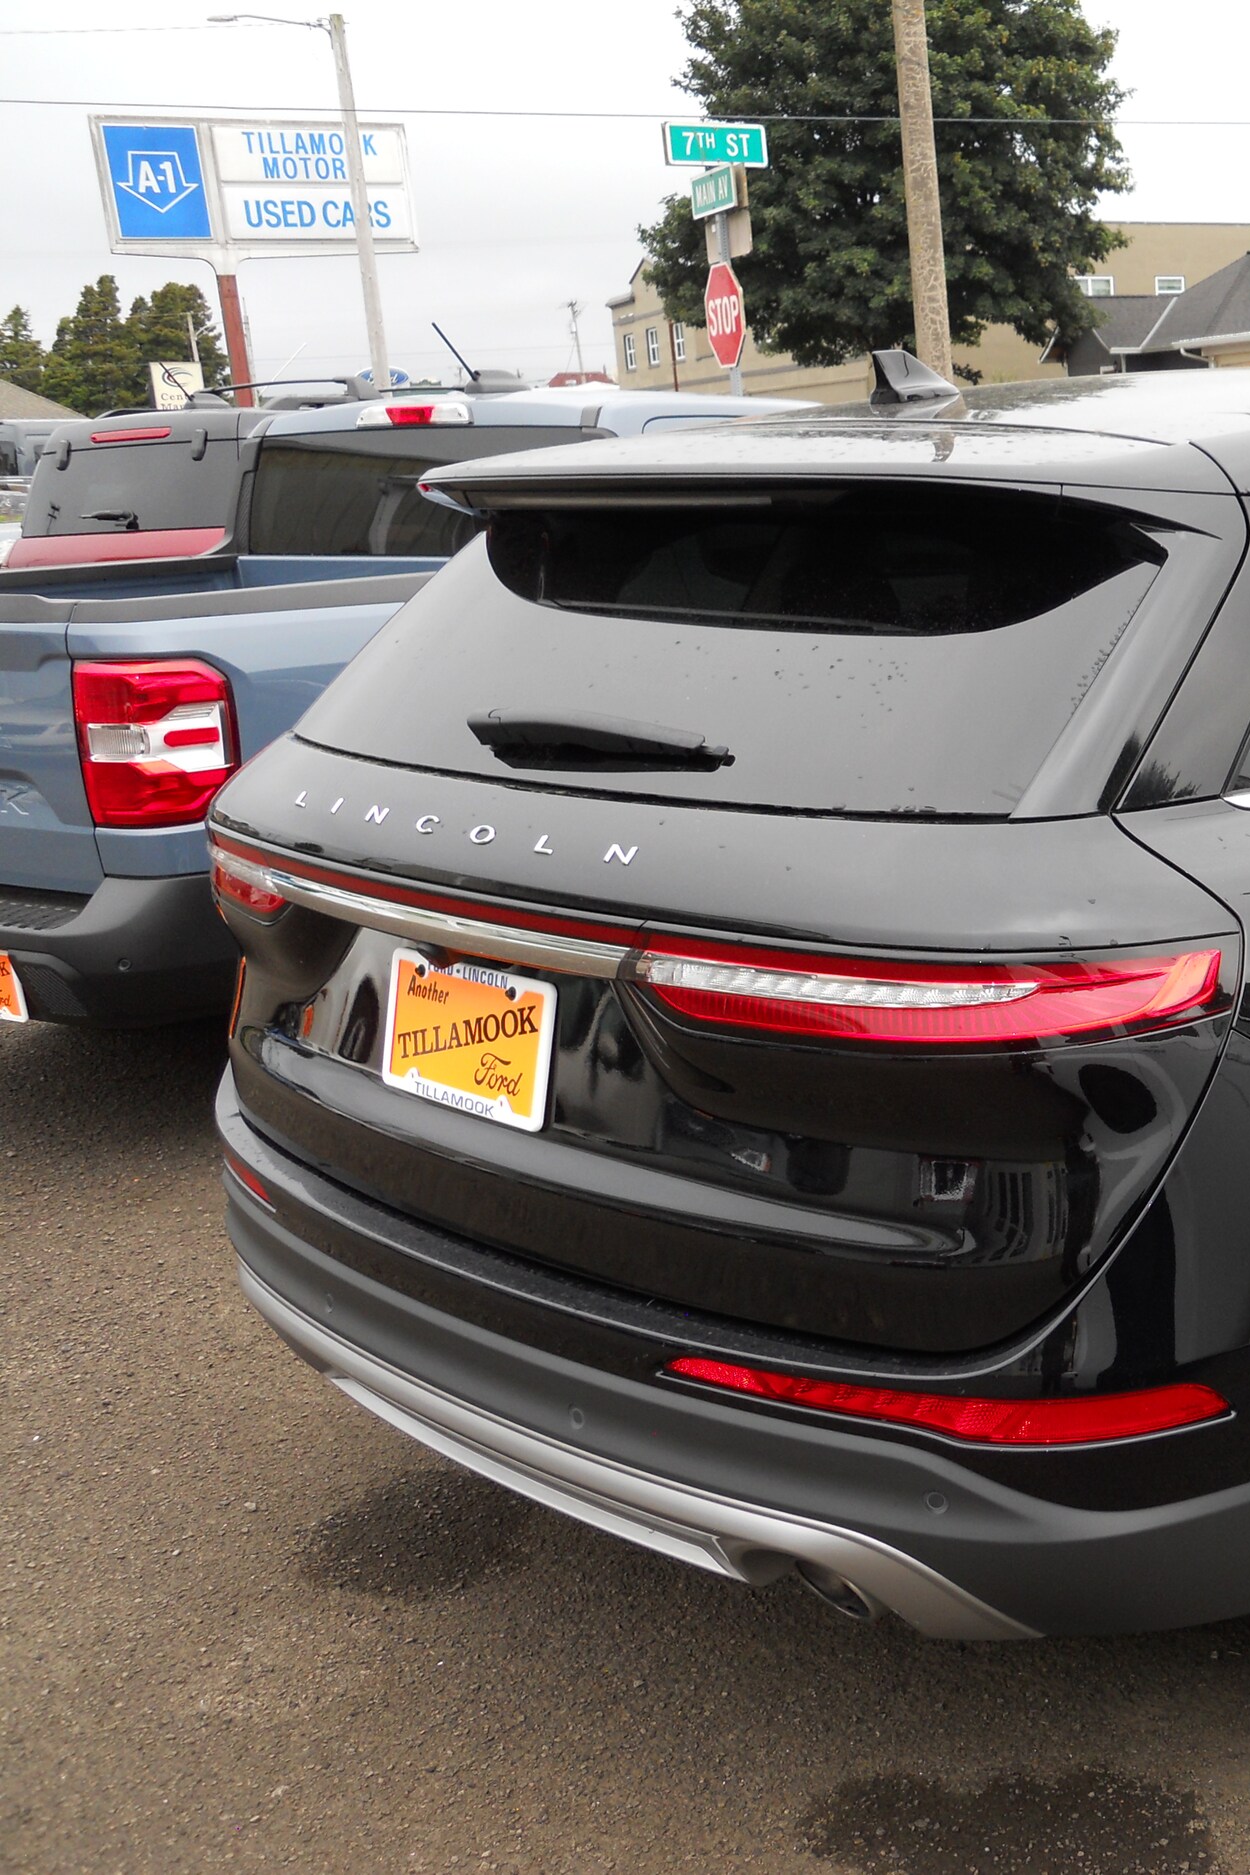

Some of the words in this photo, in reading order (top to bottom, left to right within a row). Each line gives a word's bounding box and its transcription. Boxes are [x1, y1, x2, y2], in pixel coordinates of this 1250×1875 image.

[241, 131, 378, 156] TILLAMOK
[682, 131, 716, 156] 7TH
[726, 133, 750, 157] ST
[138, 161, 177, 194] A-1
[695, 179, 717, 208] MAIN
[718, 175, 729, 200] AV
[243, 199, 316, 229] USED
[707, 295, 739, 338] STOP
[295, 791, 639, 866] LINCOLN
[407, 975, 450, 1005] Another
[462, 966, 509, 989] LINCOLN
[397, 1005, 539, 1059] TILLAMOOK
[474, 1052, 523, 1097] Ford
[414, 1081, 495, 1118] TILLAMOOK
